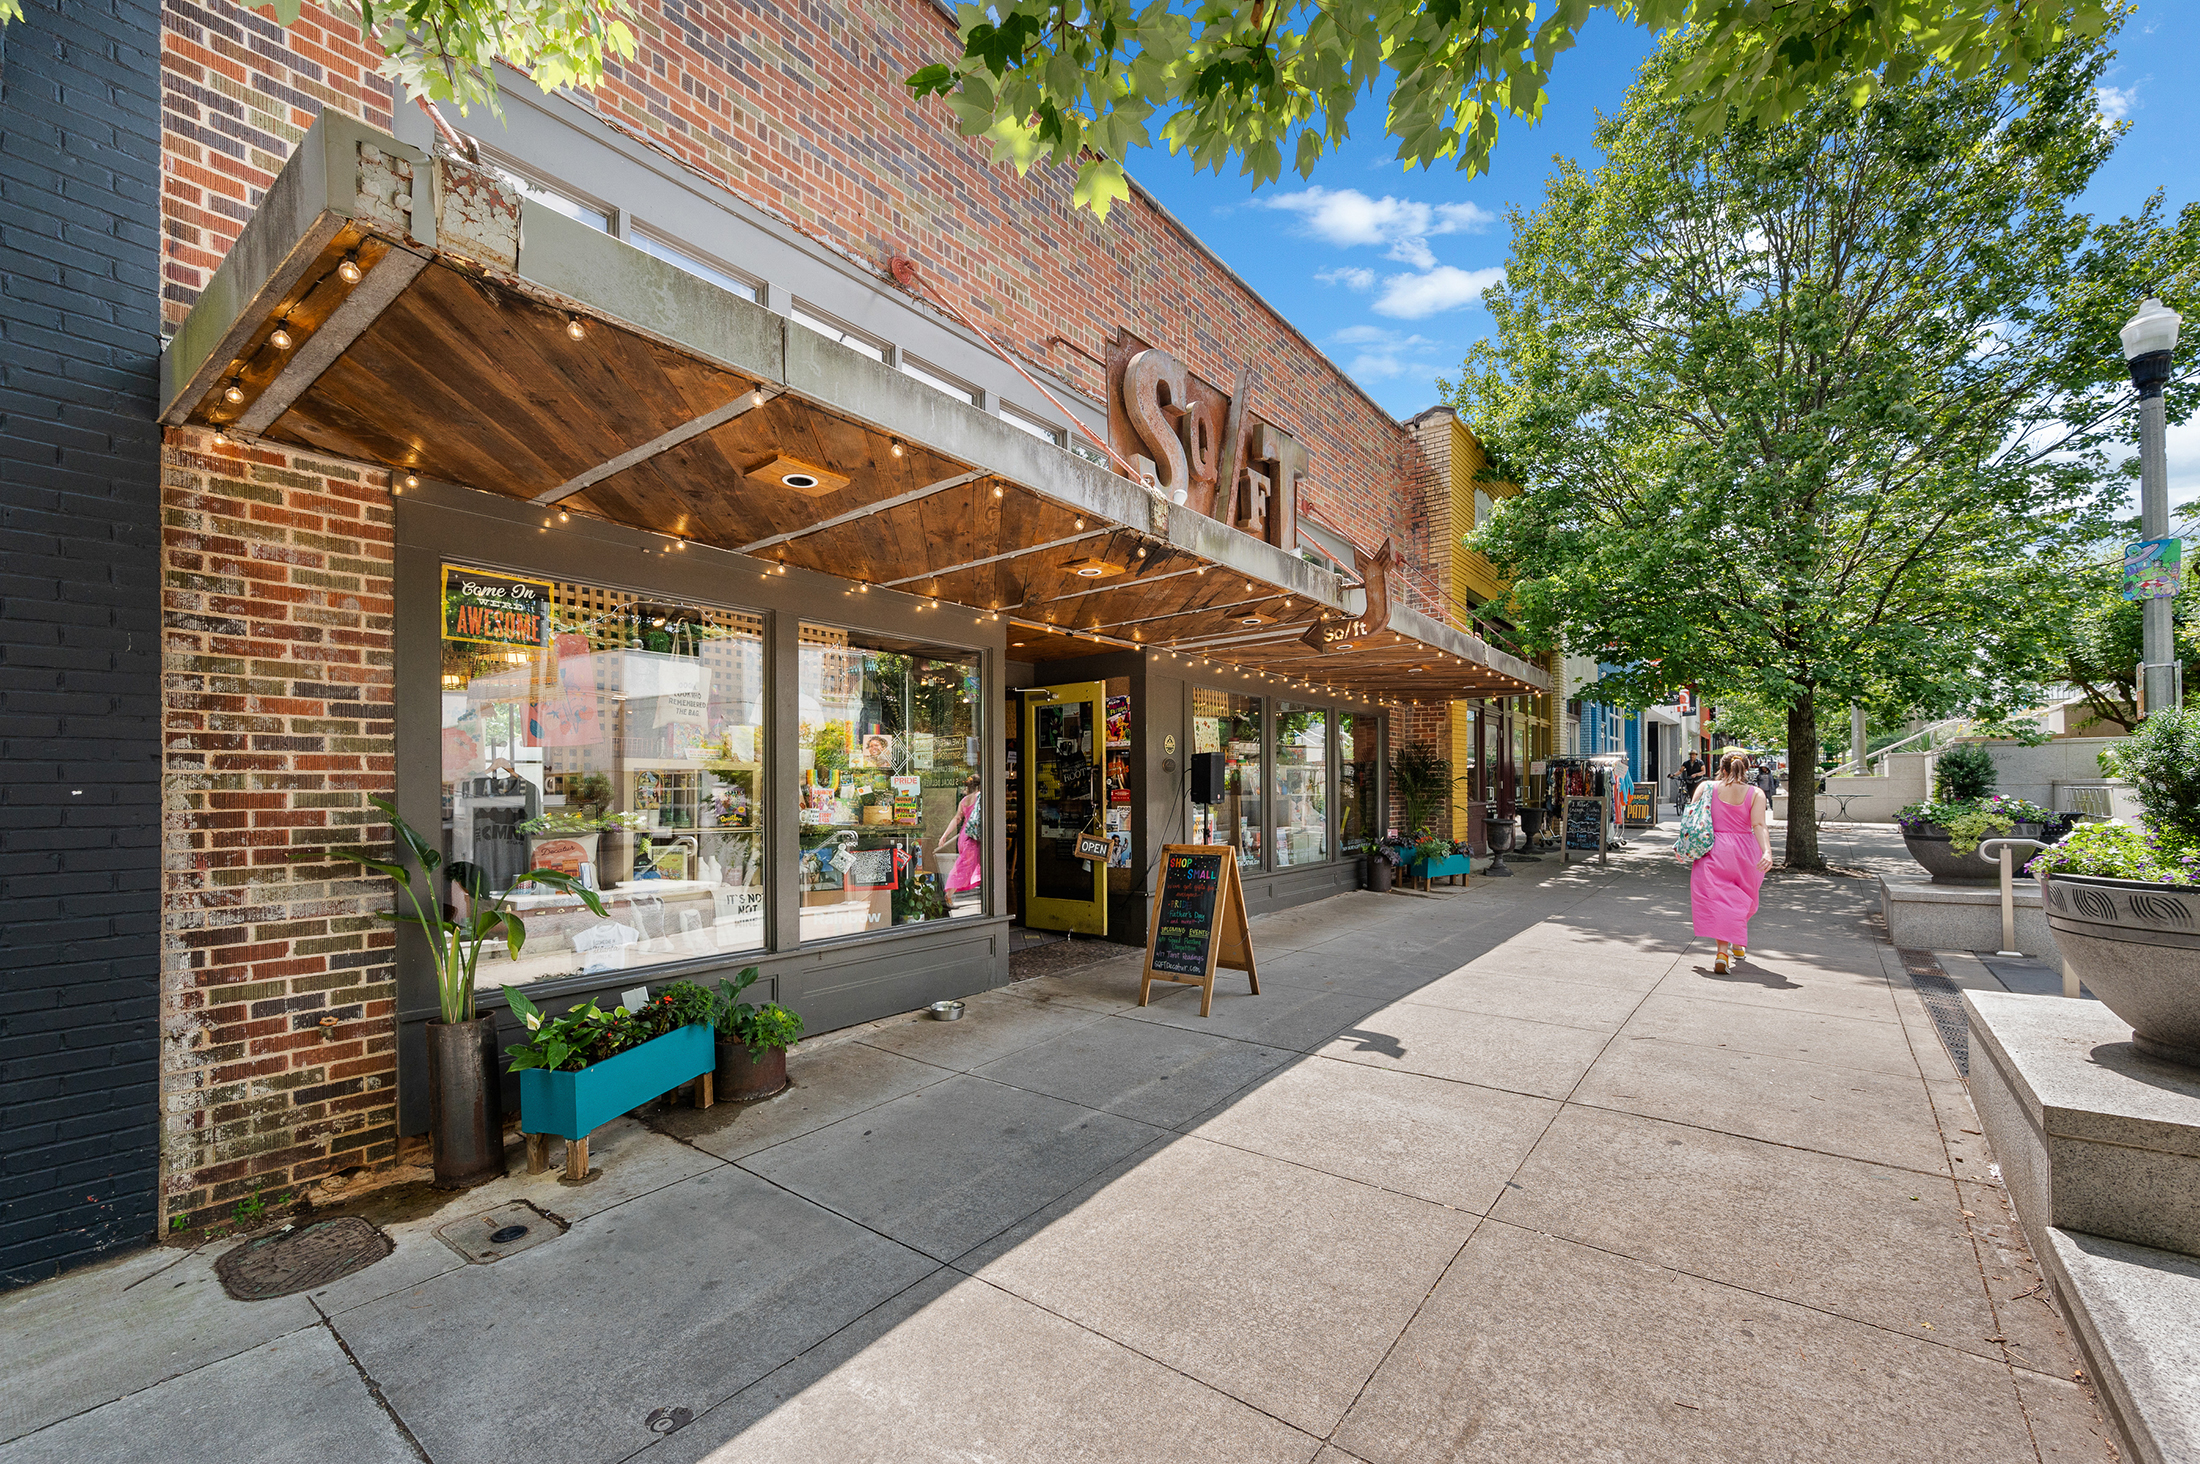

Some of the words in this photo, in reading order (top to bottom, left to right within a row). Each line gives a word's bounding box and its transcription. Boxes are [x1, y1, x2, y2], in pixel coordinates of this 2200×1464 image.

[461, 580, 507, 598] Come
[511, 583, 537, 600] In
[456, 604, 541, 643] AWESOME
[675, 708, 687, 716] THE
[893, 776, 918, 785] PRIDE
[1063, 767, 1087, 783] ROOT
[1626, 804, 1650, 819] PATIO
[540, 845, 576, 856] Decatur
[1081, 841, 1108, 855] OPEN
[1169, 857, 1193, 868] SHOP
[1186, 868, 1216, 880] SMALL
[726, 893, 746, 905] IT'S
[747, 893, 764, 903] NO
[1170, 899, 1193, 910] PRIDE
[737, 904, 758, 915] NOT
[813, 911, 882, 925] Rainbow
[1193, 911, 1206, 923] Day
